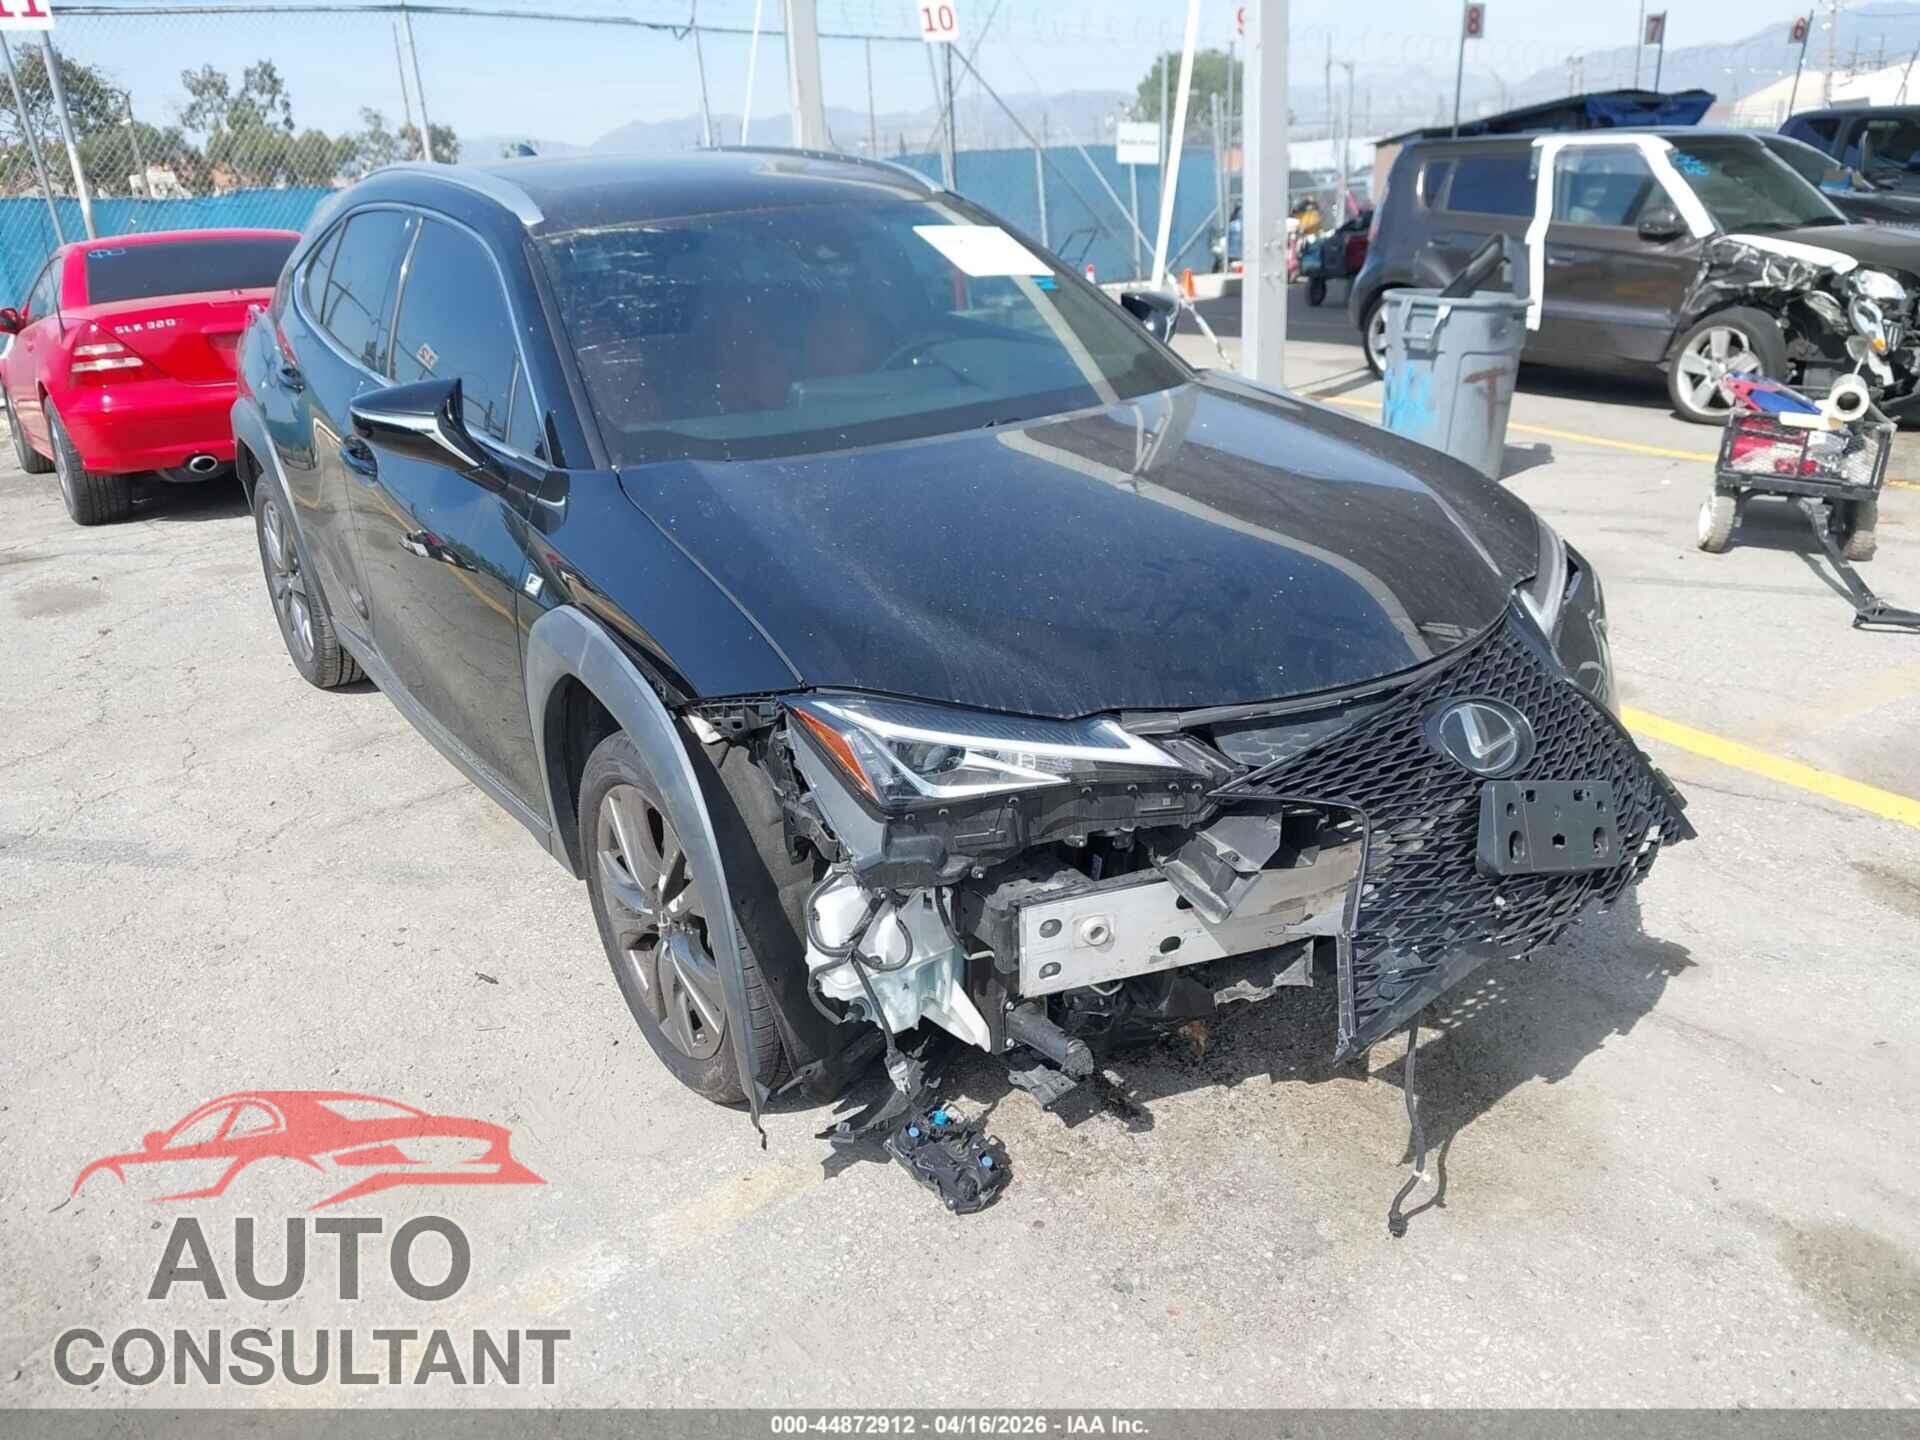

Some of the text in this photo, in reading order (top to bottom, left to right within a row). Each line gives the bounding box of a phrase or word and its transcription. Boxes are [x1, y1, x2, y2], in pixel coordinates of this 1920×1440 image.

[922, 6, 953, 32] 10
[1466, 7, 1479, 33] 8
[1650, 16, 1661, 41] 7
[1794, 17, 1806, 40] 6
